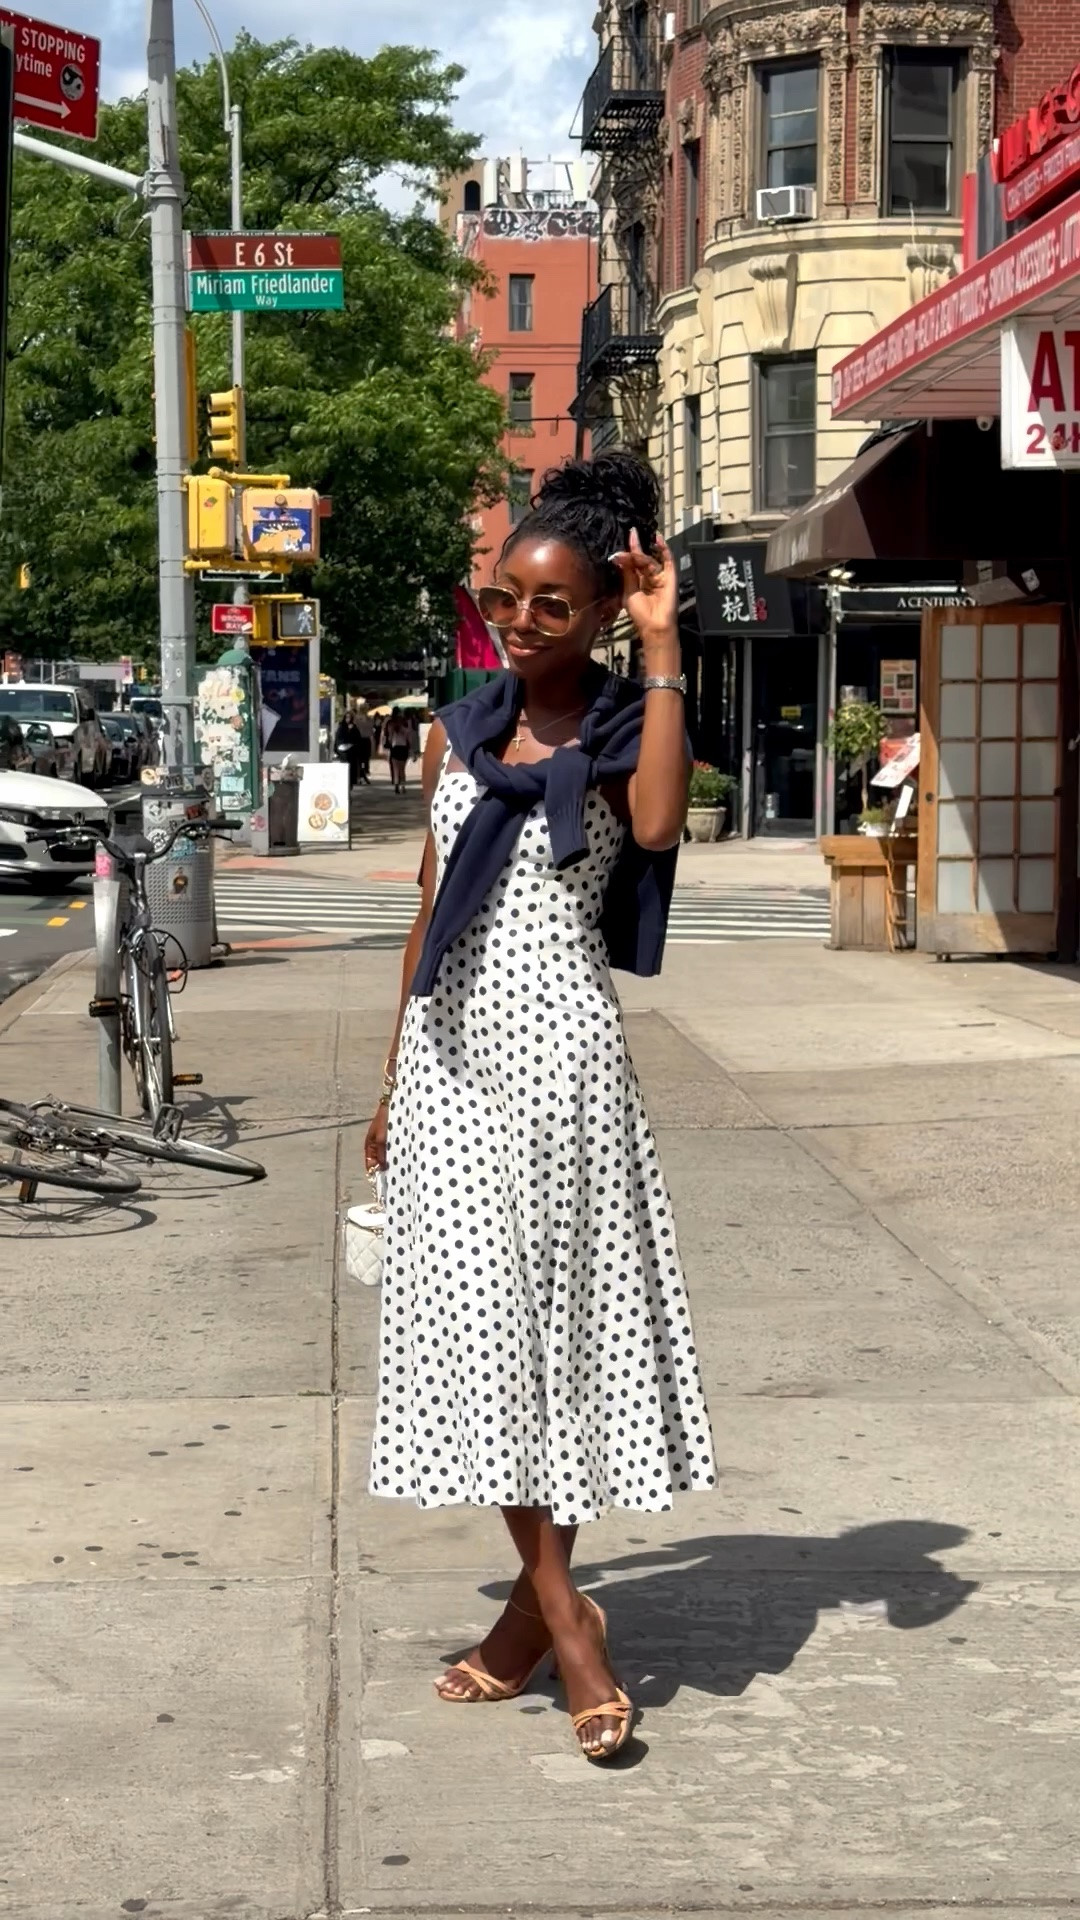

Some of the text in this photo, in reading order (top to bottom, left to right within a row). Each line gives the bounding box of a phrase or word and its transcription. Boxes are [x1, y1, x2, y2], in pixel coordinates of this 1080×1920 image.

[22, 27, 85, 63] STOPPING
[235, 241, 294, 267] E 6 St
[197, 273, 335, 295] Miriam Friedlander
[255, 295, 278, 307] Way
[717, 555, 751, 622] 蘇杭
[897, 597, 907, 608] A
[221, 614, 248, 622] WRONG
